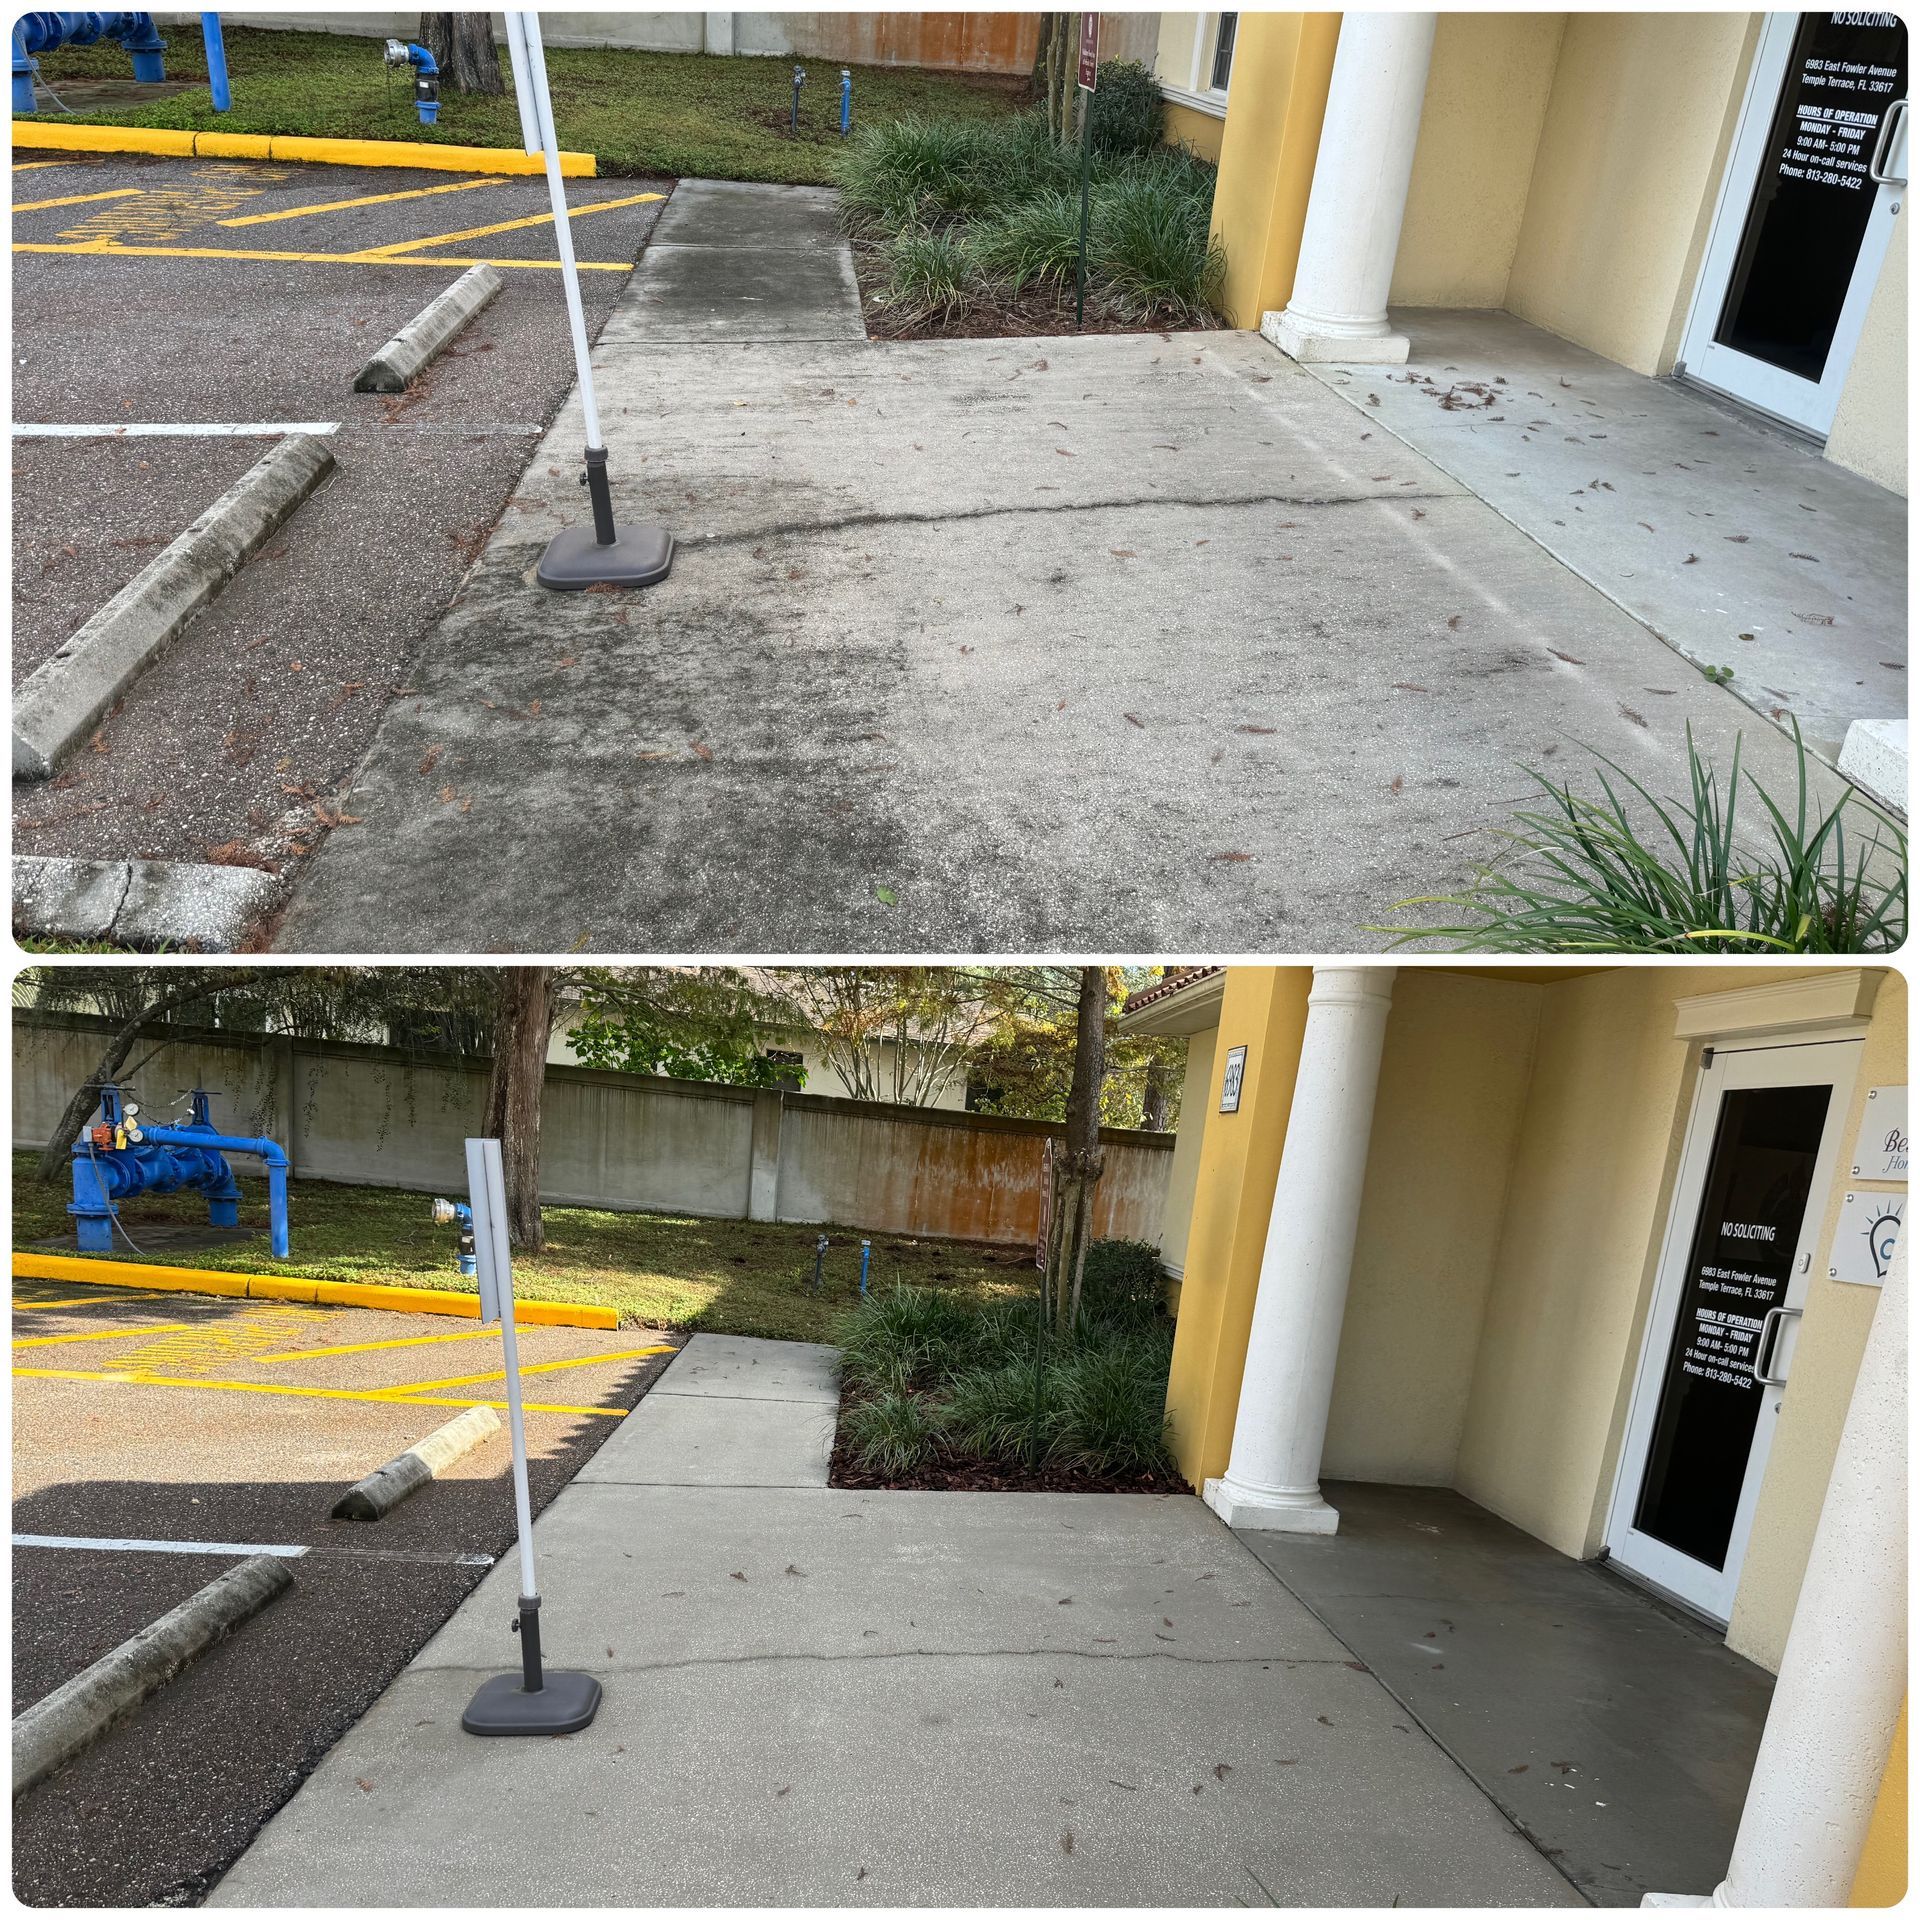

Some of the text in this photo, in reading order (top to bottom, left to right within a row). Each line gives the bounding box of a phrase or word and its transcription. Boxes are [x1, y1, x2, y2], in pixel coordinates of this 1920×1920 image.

[1831, 12, 1898, 28] NO SOLICITING
[1805, 59, 1897, 78] 6983 East Fowler Avenue
[1801, 73, 1894, 93] Temple Terrace, FL 33617
[1797, 104, 1879, 125] HOURS OF OPERATION
[1800, 121, 1832, 135] MONDAY
[1837, 127, 1866, 140] FRIDAY
[1796, 136, 1812, 147] 9:00
[1829, 141, 1846, 153] 5:00
[1847, 144, 1861, 156] PM
[1782, 148, 1868, 173] 24 Hour on-call services
[1778, 163, 1863, 190] Phone: 813-280-5422
[1883, 1127, 1908, 1152] Be
[1720, 1221, 1776, 1241] NO SOLICITING
[1701, 1266, 1777, 1287] 6983 East Fowler Avenue
[1699, 1279, 1775, 1301] Temple Terrace, FL 33617
[1696, 1307, 1763, 1329] HOURS OF OPERATION
[1698, 1323, 1725, 1337] MONDAY
[1729, 1330, 1754, 1343] FRIDAY
[1685, 1347, 1693, 1357] 24
[1693, 1349, 1708, 1360] Hour
[1707, 1354, 1729, 1367] on-call
[1696, 1336, 1710, 1347] 9:00
[1723, 1343, 1738, 1354] 5:00
[1738, 1346, 1749, 1357] PM
[1683, 1361, 1752, 1389] Phone: 813-280-5422
